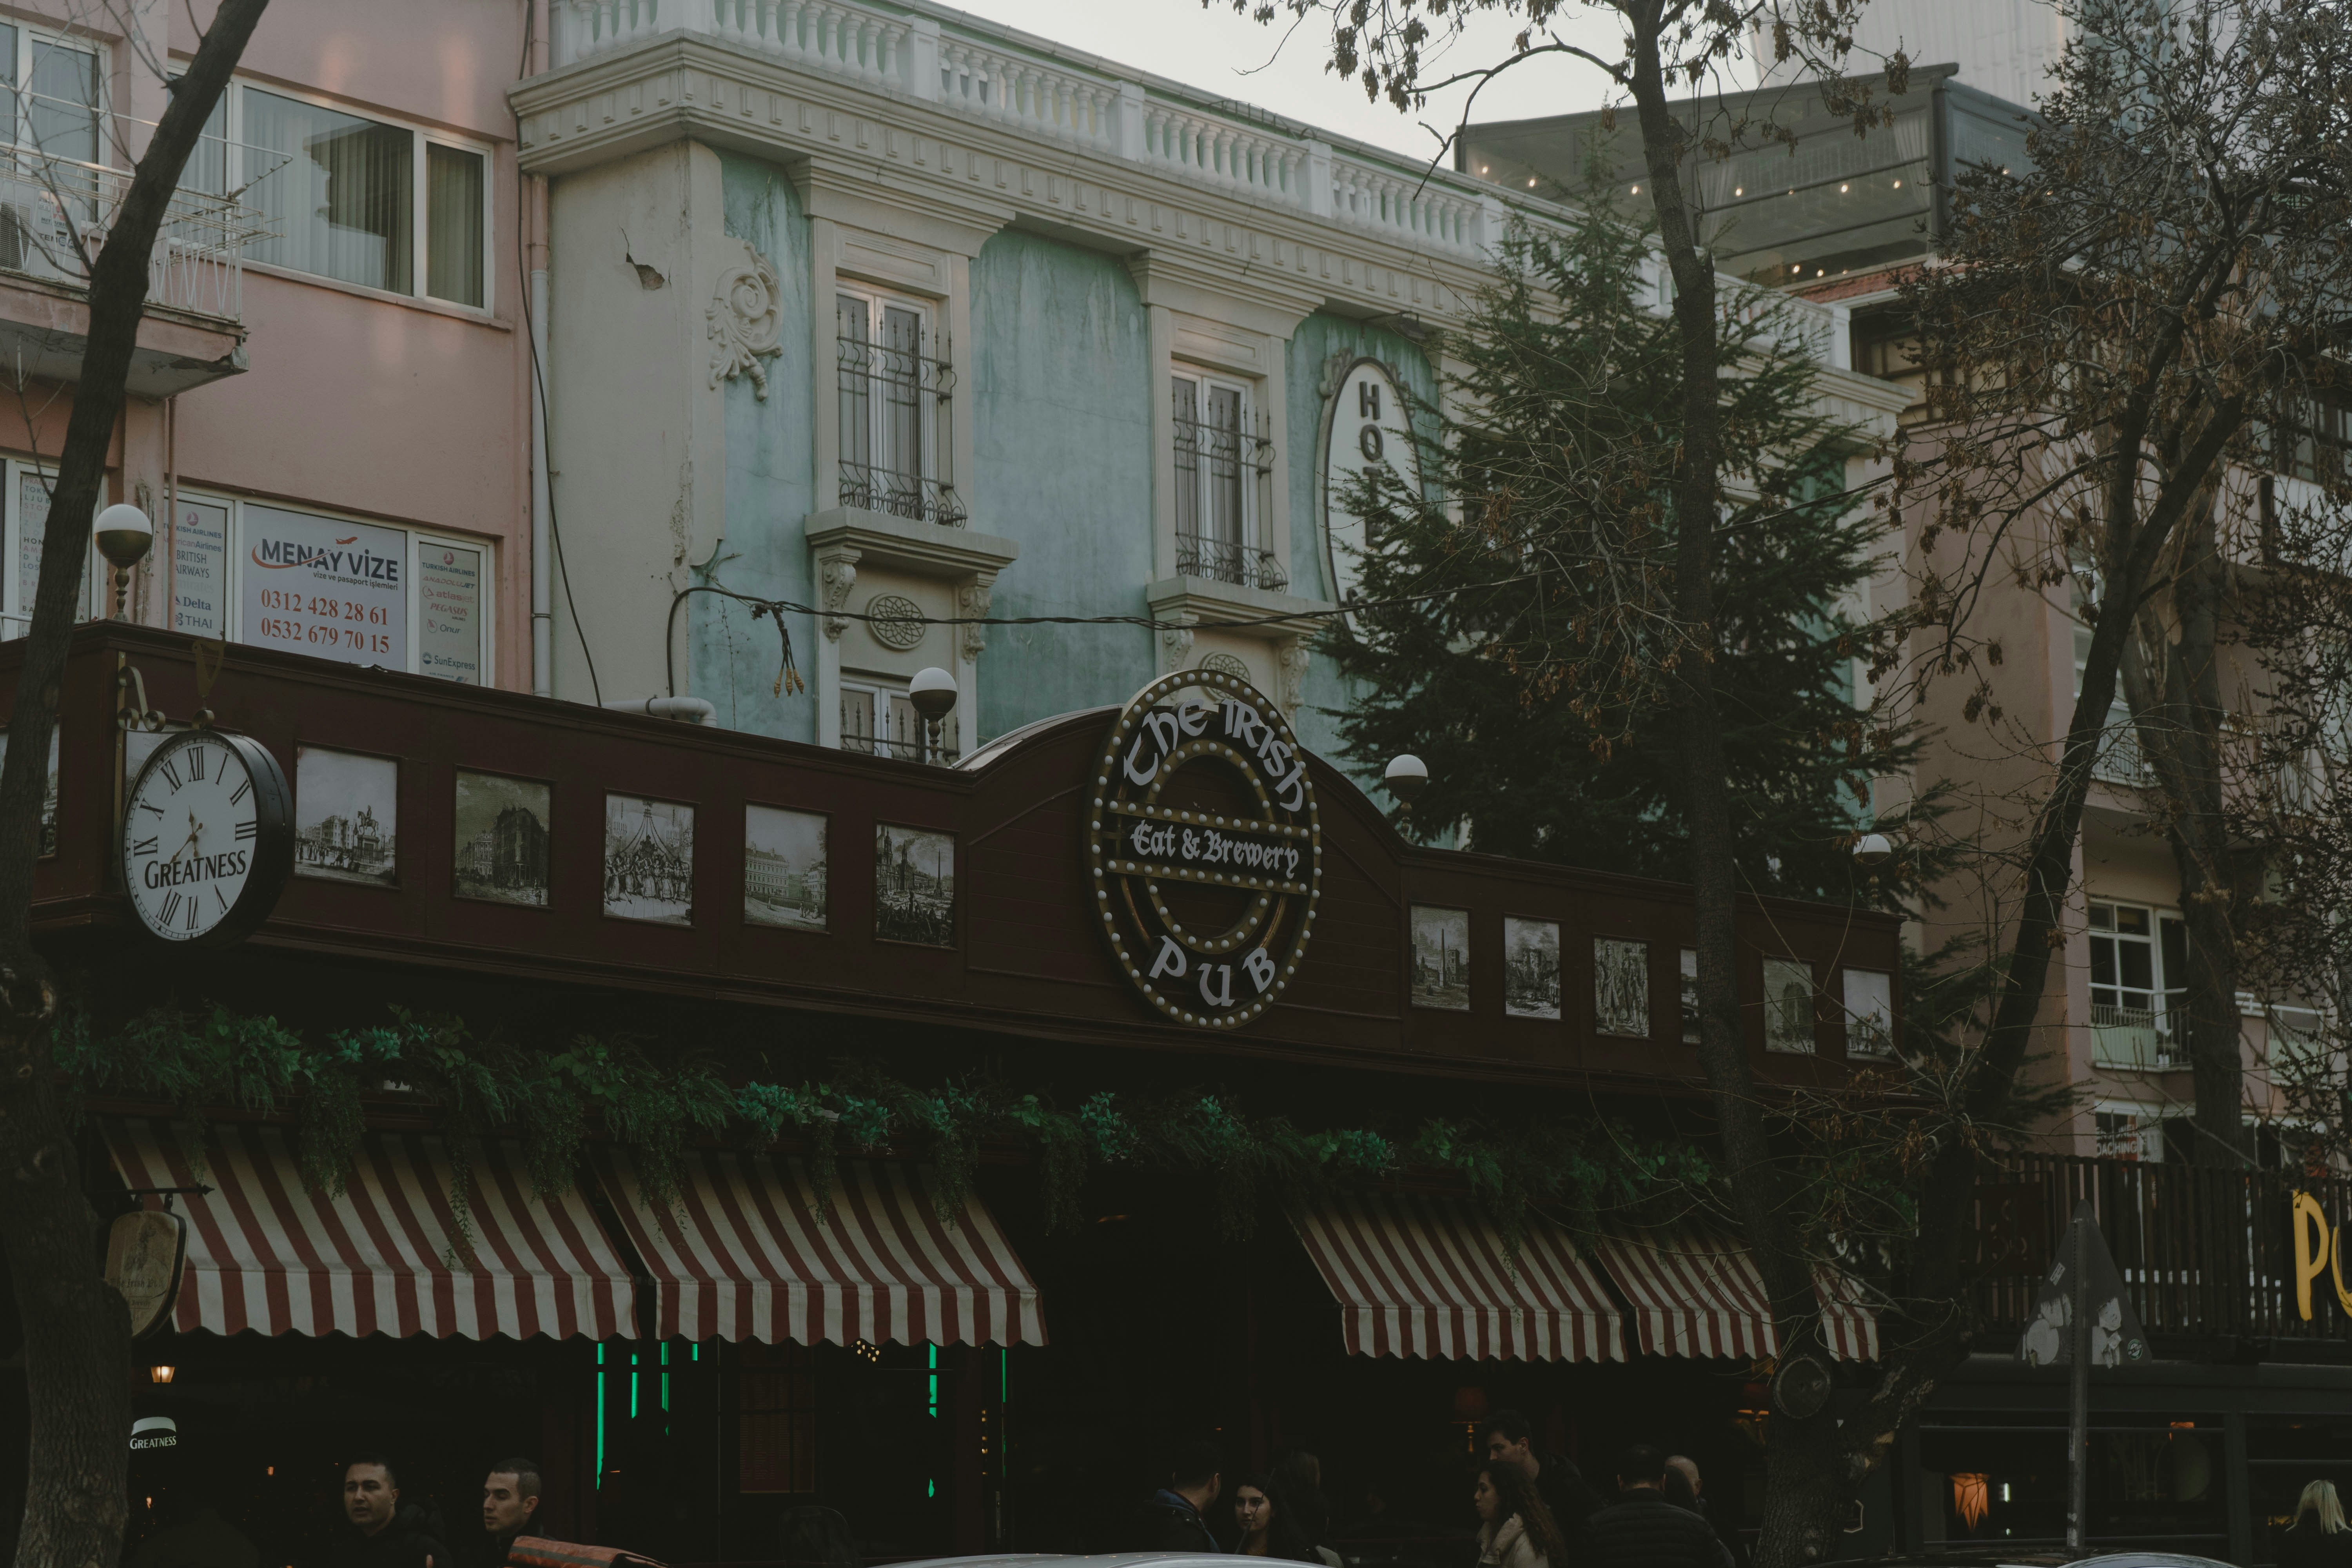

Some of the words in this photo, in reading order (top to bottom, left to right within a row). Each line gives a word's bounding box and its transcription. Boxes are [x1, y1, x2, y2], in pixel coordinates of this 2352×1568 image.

[192, 528, 222, 539] AIRLINES
[176, 550, 207, 564] BRITISH
[262, 539, 343, 572] MENAY
[348, 549, 398, 581] VİZE
[422, 562, 448, 572] TURKISH
[449, 567, 475, 577] AIRLINES
[338, 576, 368, 586] pasaport
[370, 580, 398, 591] işlemleri
[423, 576, 475, 589] ANADOLUJET
[183, 597, 211, 610] Delta
[436, 591, 474, 603] atlasjet
[261, 589, 301, 612] 0312
[308, 597, 338, 618] 428
[344, 602, 364, 622] 28
[370, 607, 388, 625] 61
[430, 603, 468, 617] PEGASUS
[185, 615, 212, 629] THAI
[440, 624, 461, 634] Onur
[261, 618, 301, 641] 0532
[308, 625, 338, 645] 679
[344, 630, 364, 650] 70
[370, 634, 389, 653] 15
[434, 655, 475, 671] SunExpress
[187, 746, 205, 782] XII
[1130, 819, 1176, 857] Eat
[1181, 828, 1201, 860] &
[1202, 829, 1299, 879] Brewery
[144, 850, 246, 889] GREATNESS
[1149, 935, 1276, 1007] PUB
[130, 1436, 176, 1449] GREATNESS
